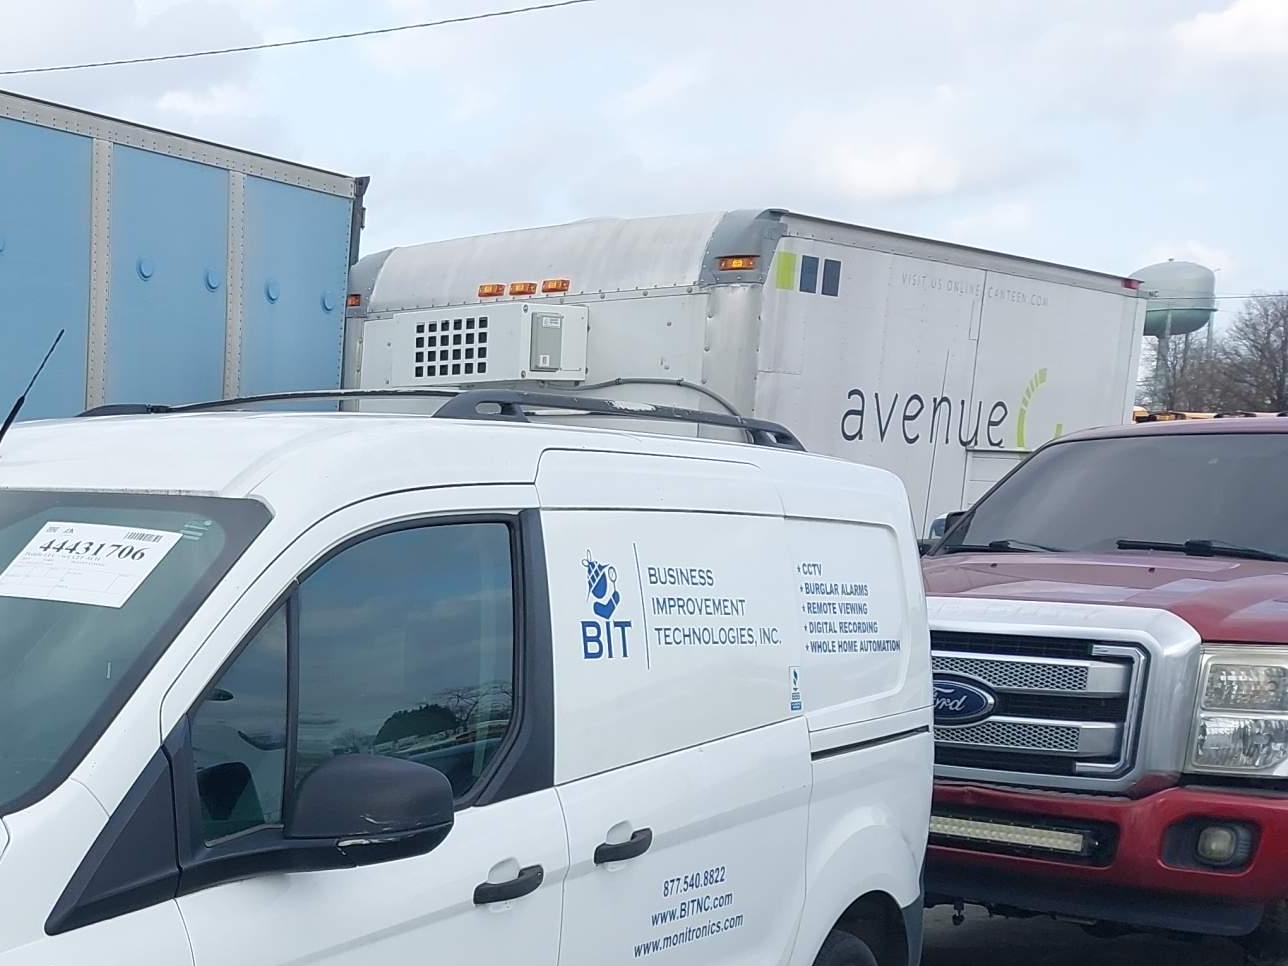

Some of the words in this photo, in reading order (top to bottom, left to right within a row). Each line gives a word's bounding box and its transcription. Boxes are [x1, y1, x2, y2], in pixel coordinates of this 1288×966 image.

[902, 272, 927, 287] VISIT
[931, 278, 943, 290] US
[946, 279, 981, 297] ONLINE
[841, 388, 1009, 448] avenue
[39, 538, 152, 561] 44431706
[647, 566, 714, 587] BUSINESS
[802, 562, 822, 577] CCTV
[804, 582, 839, 596] BURGLAR
[841, 584, 869, 596] ALARMS
[652, 596, 745, 616] IMPROVEMENT
[806, 601, 837, 615] REMOTE
[838, 602, 868, 615] VIEWING
[654, 627, 758, 647] TECHNOLOGIES,
[759, 627, 782, 645] INC.
[808, 621, 838, 634] DIGITAL
[839, 621, 878, 634] RECORDING
[581, 620, 632, 660] BIT
[810, 640, 837, 653] WHOLE
[838, 640, 858, 653] HOME
[859, 639, 901, 652] AUTOMATION
[663, 866, 726, 897] 877.540.8822
[651, 892, 734, 927] www.BITNC.com
[634, 914, 744, 958] www.monitronics.com
